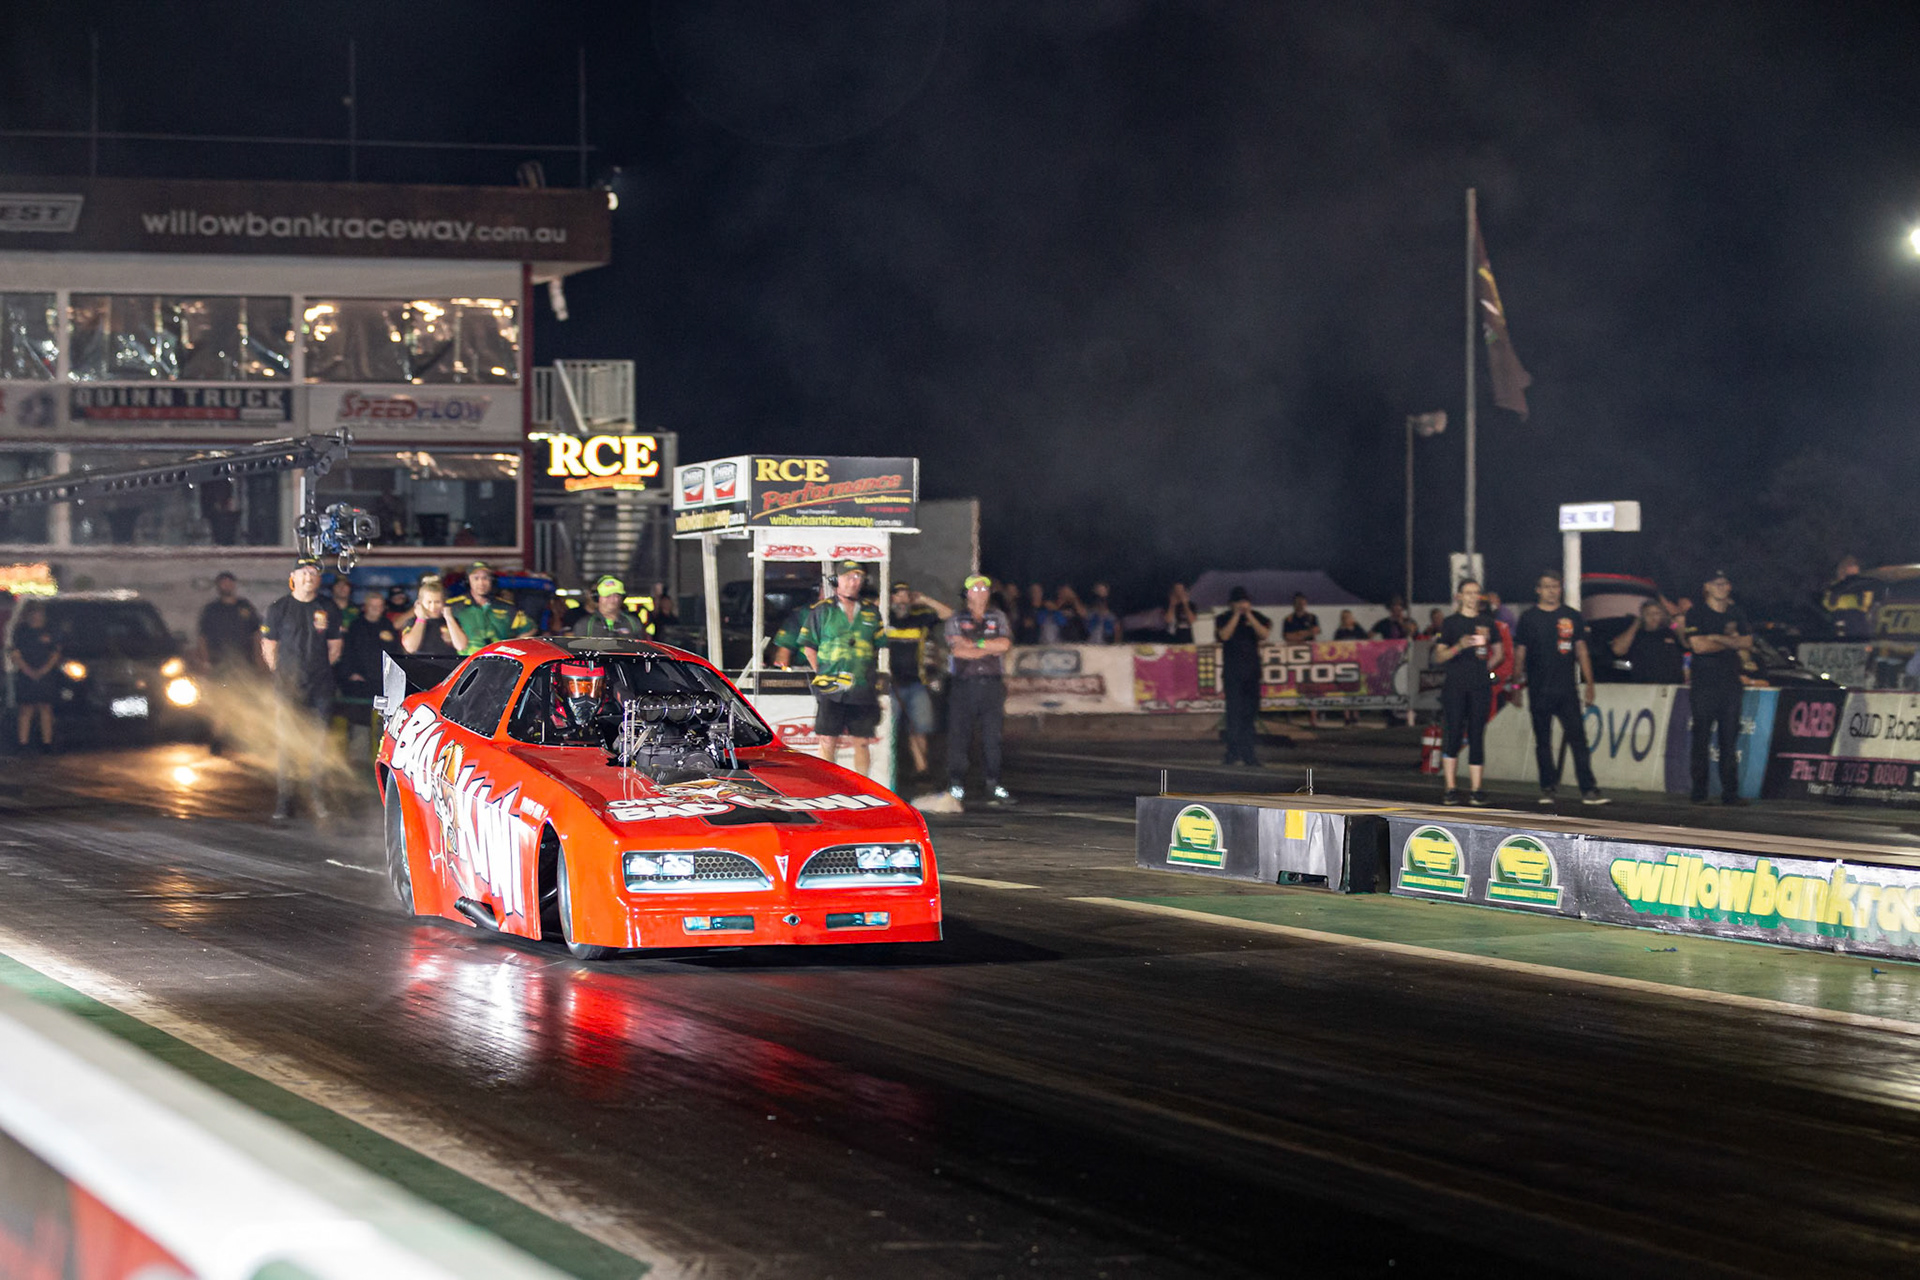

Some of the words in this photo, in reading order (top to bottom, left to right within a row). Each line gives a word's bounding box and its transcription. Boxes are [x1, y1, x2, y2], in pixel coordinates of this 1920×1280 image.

[141, 210, 567, 243] willowbankraceway.com.au
[183, 389, 284, 407] TRUCK
[546, 435, 659, 477] RCE
[755, 458, 830, 482] RCE
[761, 474, 903, 510] Performance
[390, 703, 445, 803] BAD
[607, 802, 731, 822] BAD
[728, 793, 893, 812] KIWI
[454, 764, 526, 918] KIWI
